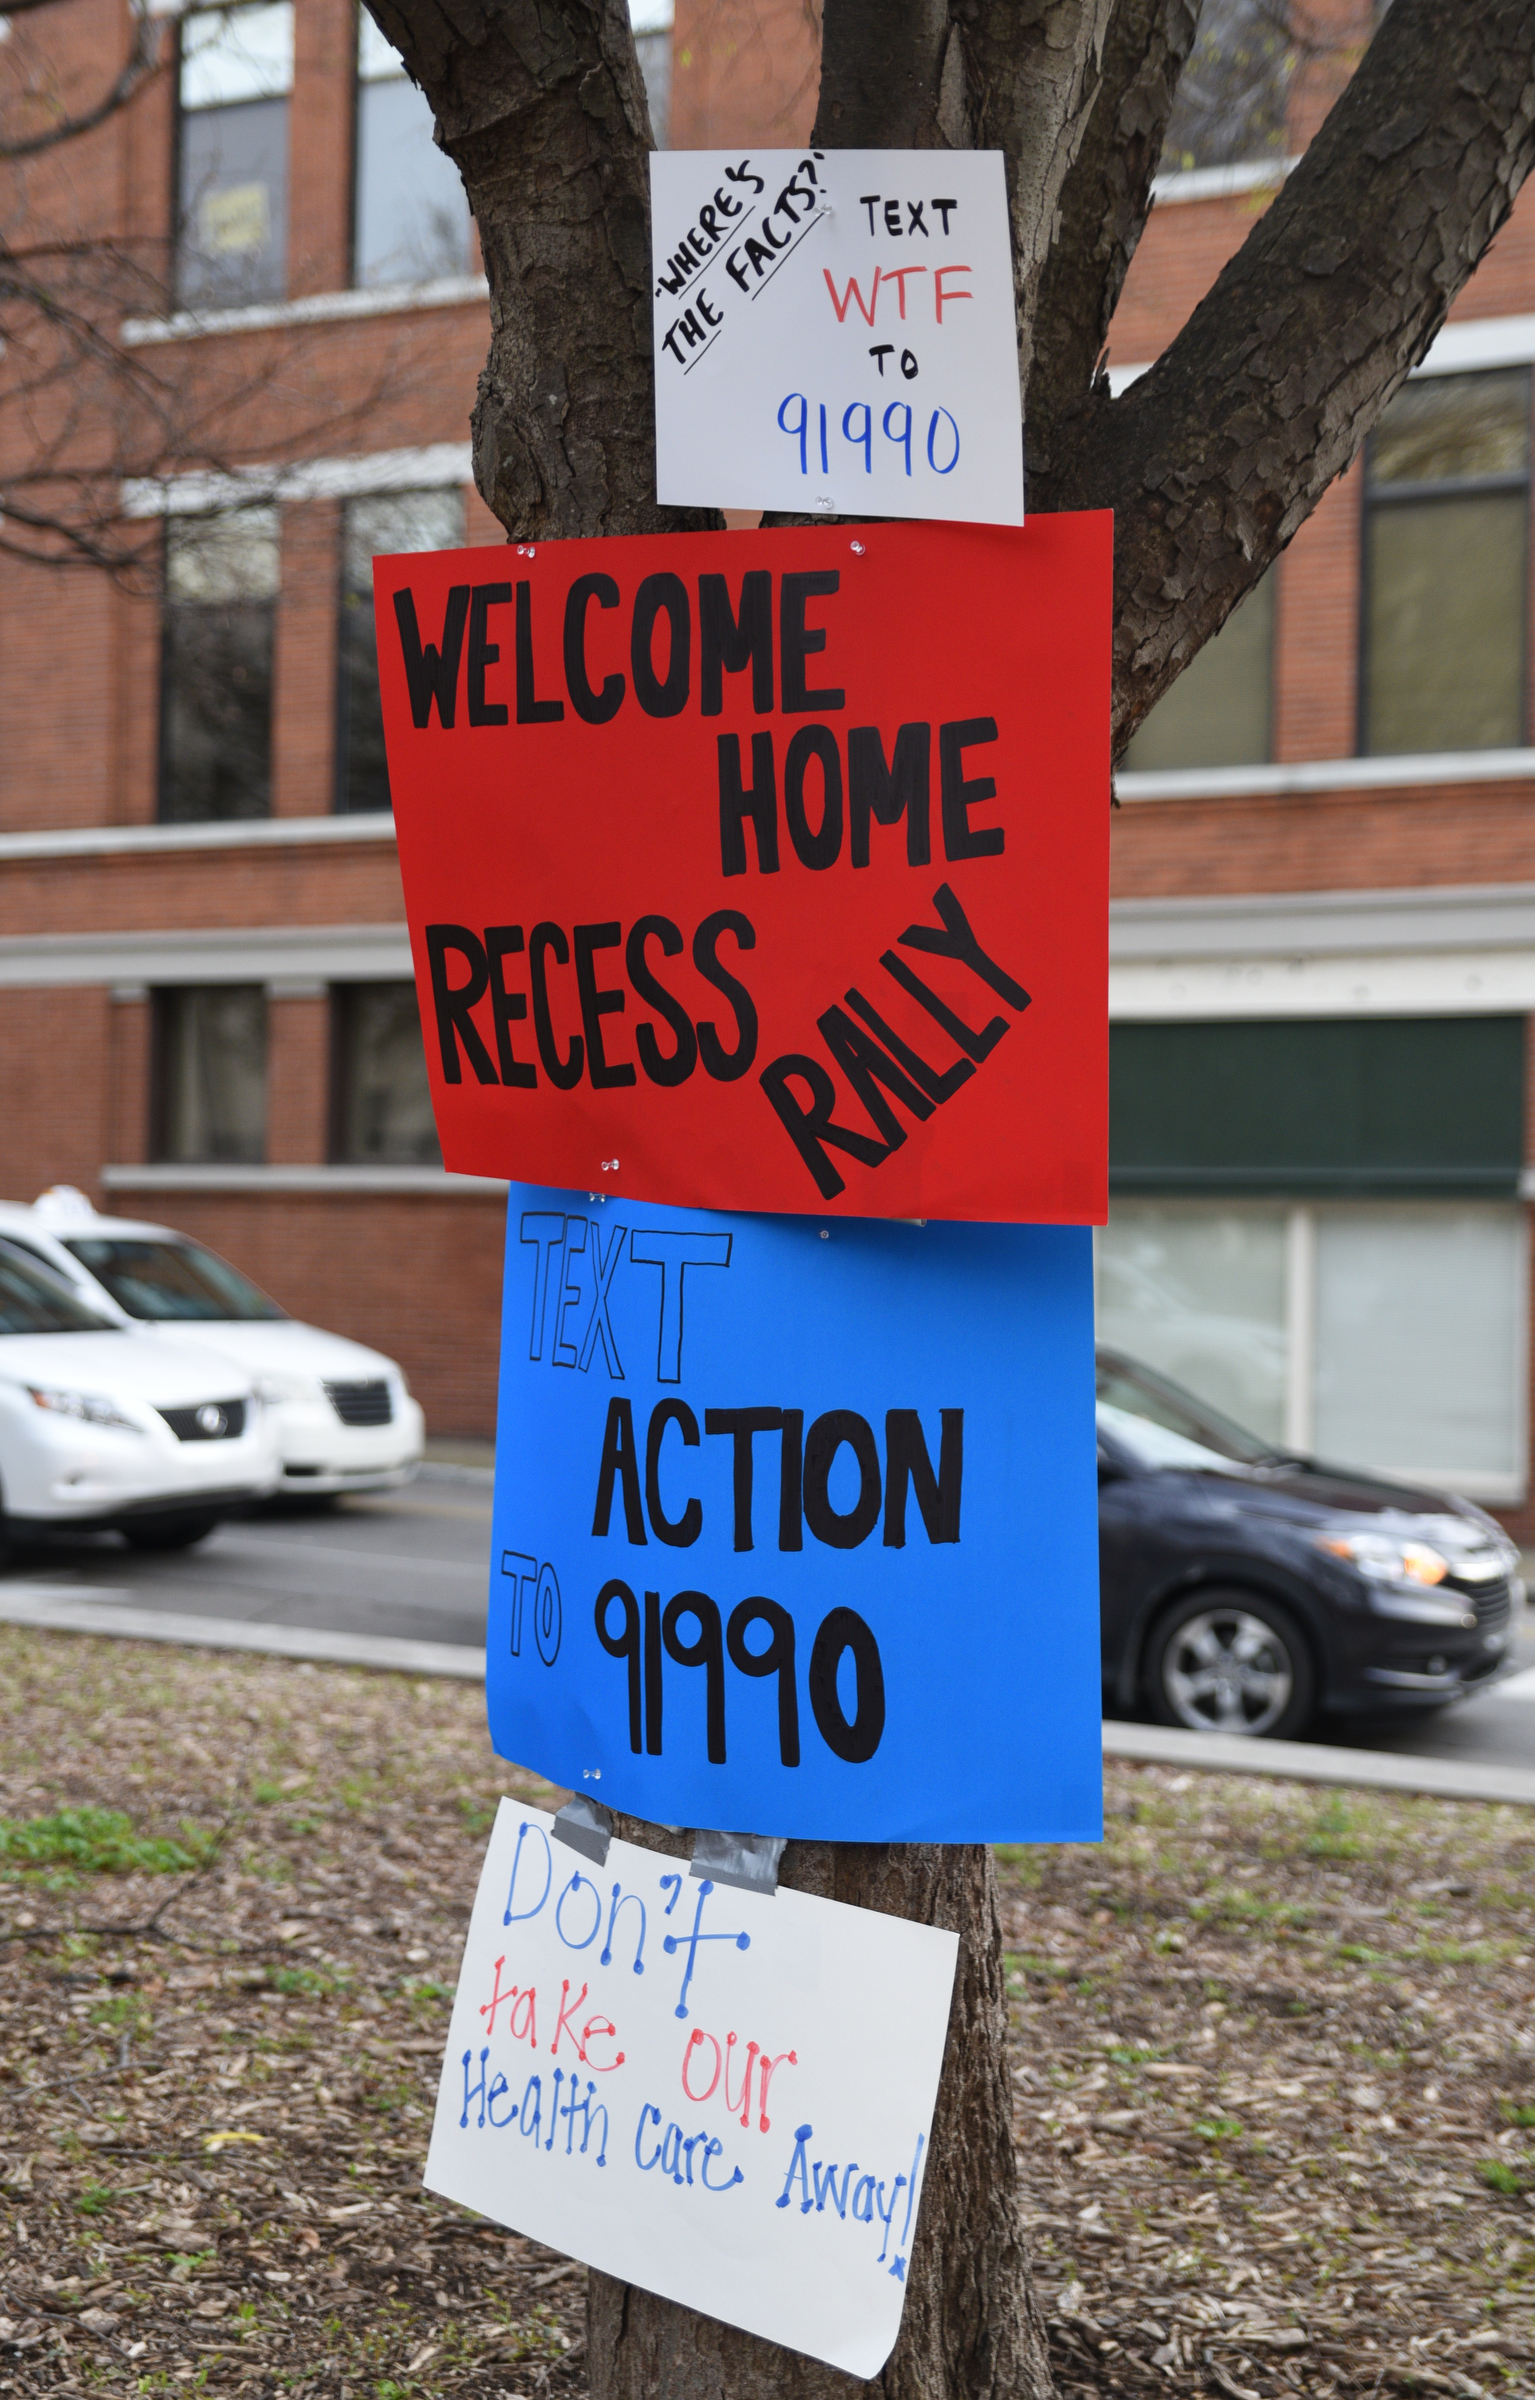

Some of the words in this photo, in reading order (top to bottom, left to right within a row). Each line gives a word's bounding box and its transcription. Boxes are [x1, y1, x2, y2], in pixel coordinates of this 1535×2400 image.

[860, 194, 958, 238] TEXT
[661, 287, 724, 365] THE
[823, 265, 974, 328] WTF
[868, 344, 919, 380] TO
[777, 392, 961, 478] 91990
[392, 569, 846, 730] WELCOME
[716, 716, 1006, 878] HOME
[424, 909, 760, 1091] RECESS
[758, 882, 1034, 1201] RALLY
[519, 1210, 734, 1385] TEXT
[591, 1396, 965, 1553] ACTION
[501, 1549, 563, 1668] TO
[594, 1578, 886, 1768] 91990
[503, 1822, 751, 2019] Don't
[682, 2027, 798, 2134] our
[460, 2046, 609, 2168] Health
[774, 2123, 926, 2283] Away!
